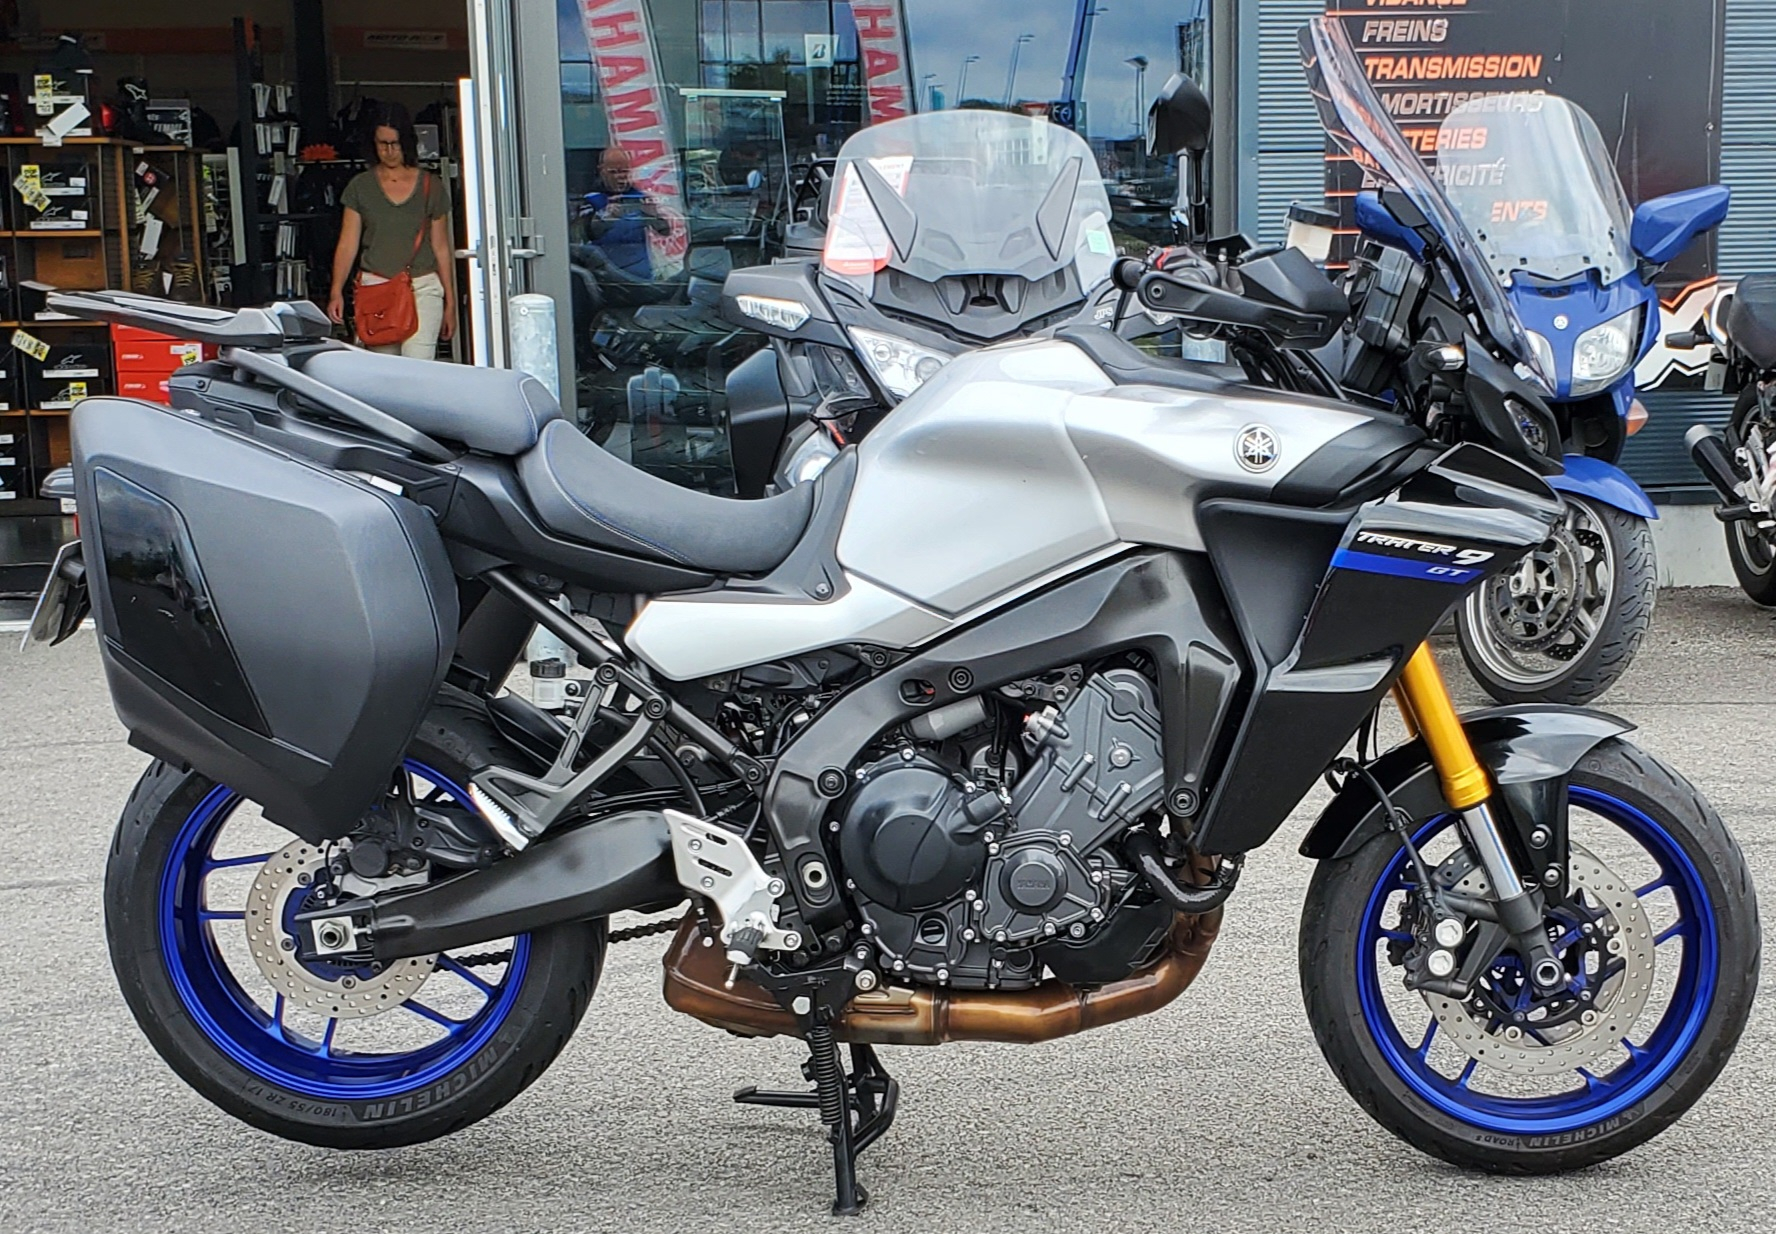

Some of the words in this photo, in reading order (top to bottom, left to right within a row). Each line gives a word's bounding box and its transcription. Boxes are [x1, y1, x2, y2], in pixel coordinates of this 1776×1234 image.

[1361, 18, 1449, 43] FREINS
[1364, 54, 1543, 81] TRANSMISSION
[1380, 89, 1546, 116] MORTISSEURS
[1452, 549, 1495, 566] 9
[1425, 566, 1472, 577] GT
[247, 1084, 264, 1096] 17
[363, 1046, 499, 1120] MICHELIN
[265, 1091, 284, 1104] ZR
[286, 1101, 338, 1118] 180/55
[1484, 1135, 1515, 1147] ROAD
[1529, 1119, 1620, 1147] MICHELIN
